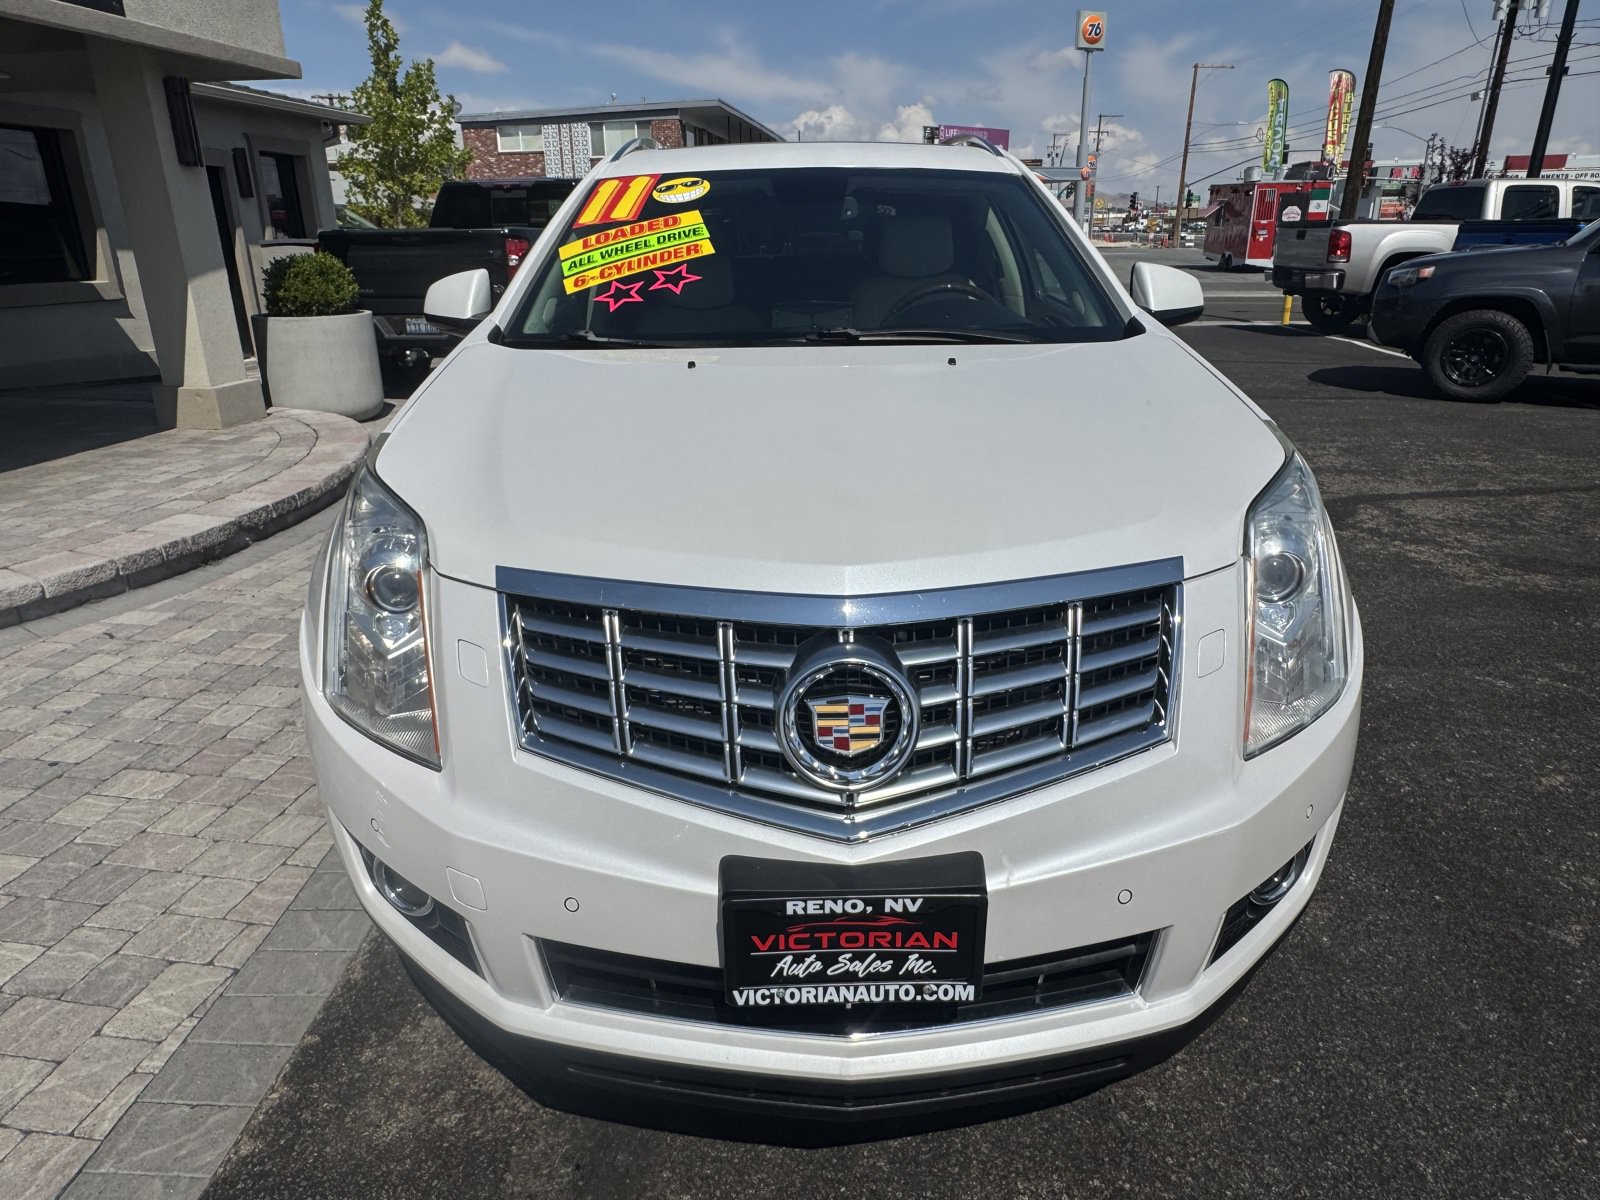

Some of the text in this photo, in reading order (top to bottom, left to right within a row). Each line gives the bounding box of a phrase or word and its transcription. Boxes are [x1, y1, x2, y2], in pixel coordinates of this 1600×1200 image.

[1087, 21, 1102, 37] 76
[1540, 172, 1569, 180] NMENTS
[1589, 172, 1600, 180] RO
[577, 175, 655, 225] 11
[582, 215, 681, 249] LOADED
[567, 226, 704, 272] ALL WHEEL DRIVE
[573, 243, 703, 288] 6-CYLINDER
[786, 898, 924, 915] RENO, NV
[751, 931, 958, 951] VICTORIAN
[770, 952, 937, 978] Auto Sales Inc.
[732, 983, 975, 1006] VICTORIANAUTO.COM
